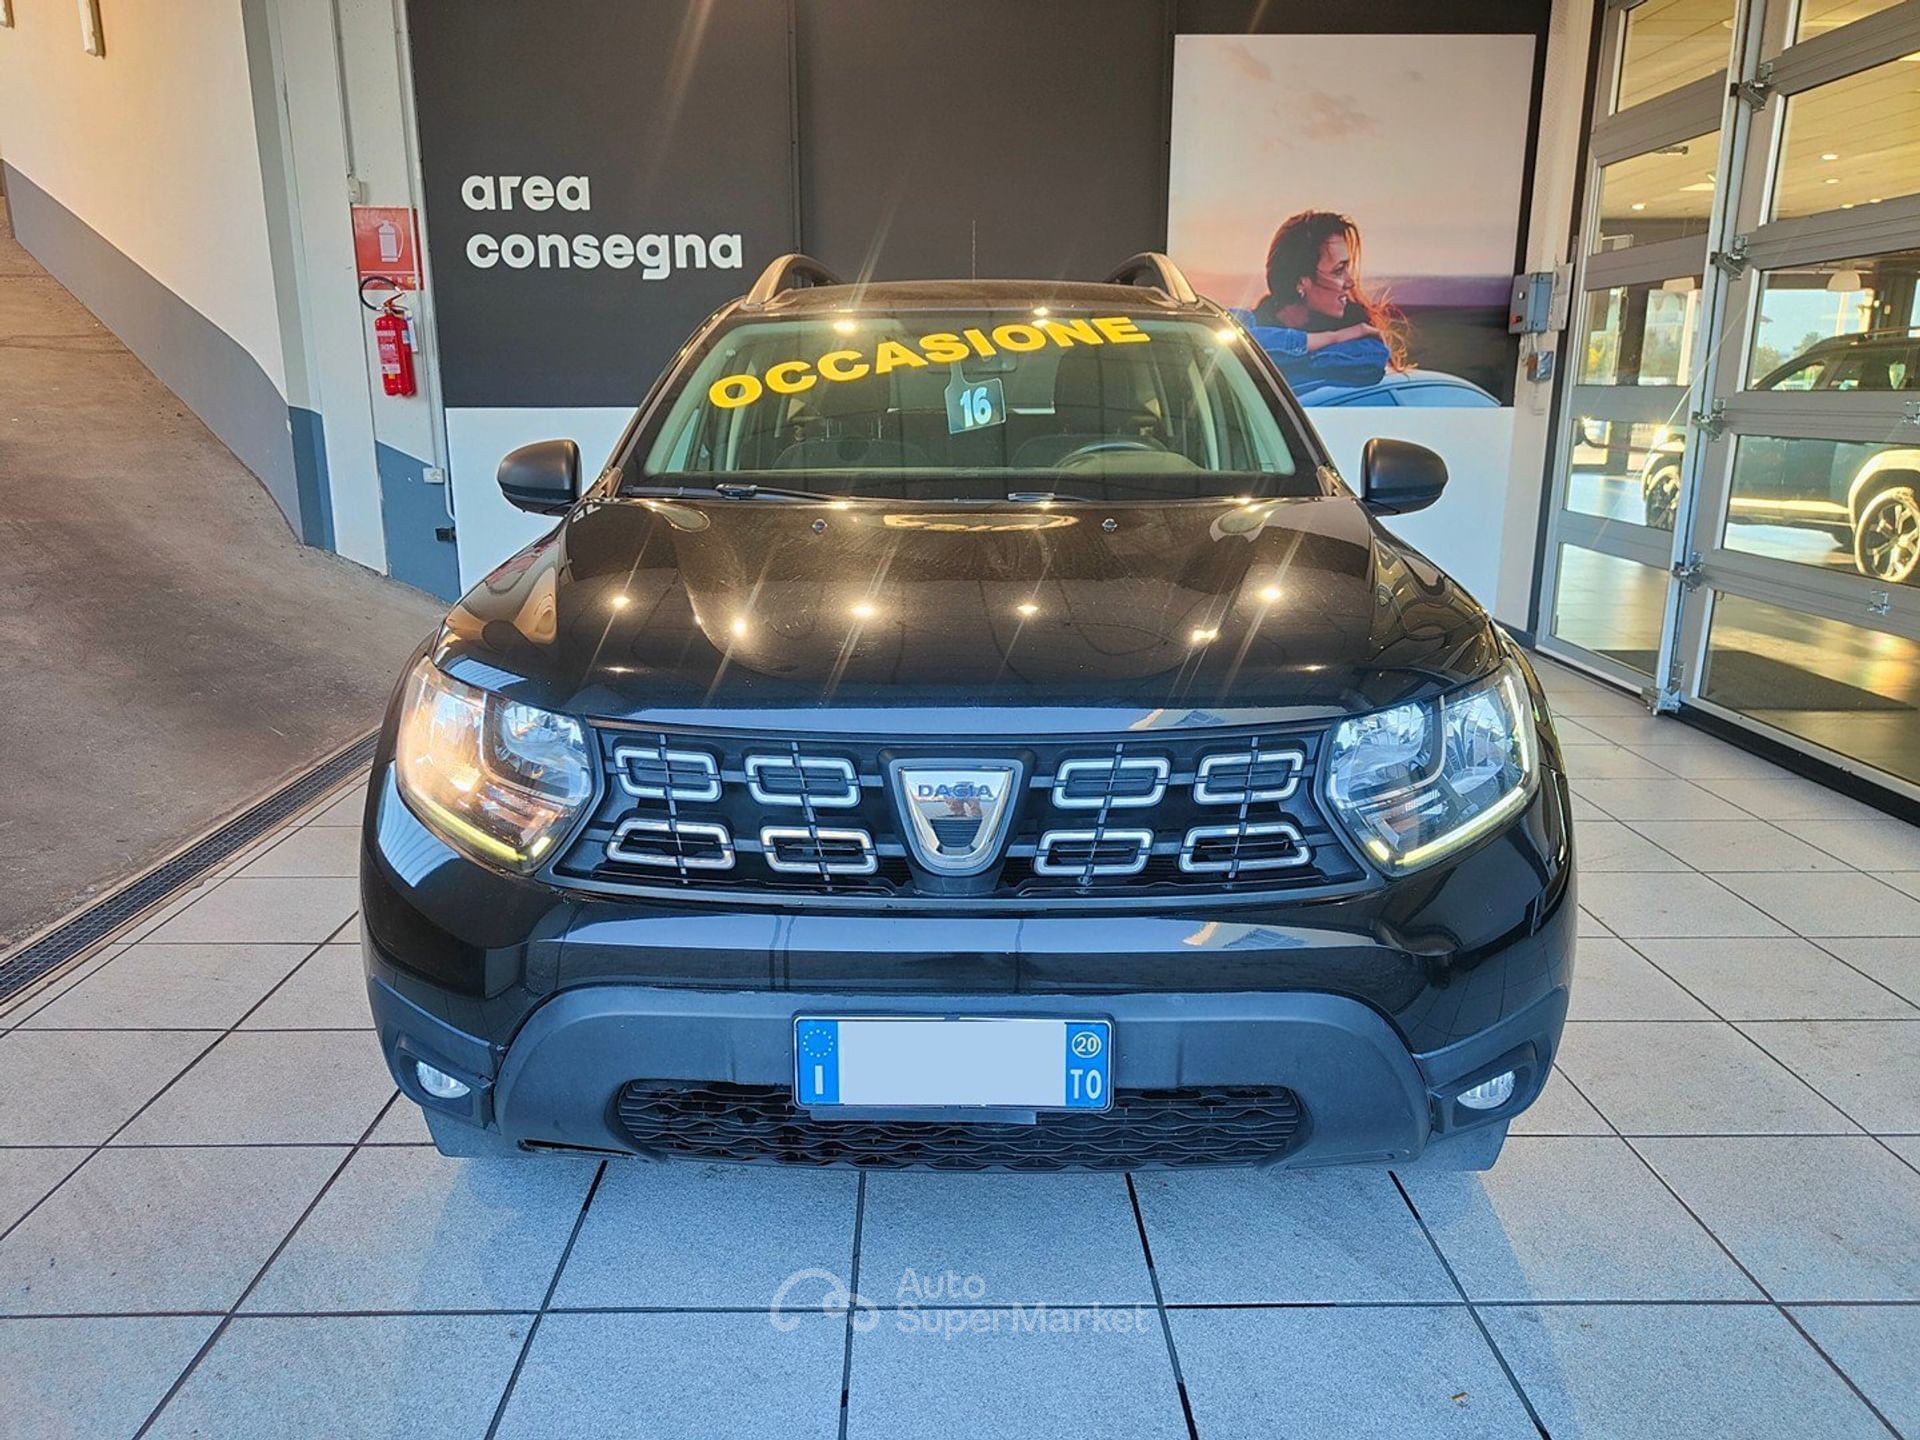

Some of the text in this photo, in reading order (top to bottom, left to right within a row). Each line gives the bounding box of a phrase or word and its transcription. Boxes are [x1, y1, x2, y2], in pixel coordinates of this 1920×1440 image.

[461, 175, 590, 211] area
[466, 233, 743, 280] consegna
[708, 316, 1151, 408] OCCASIONE
[960, 386, 992, 428] 16
[917, 784, 995, 798] DACIA
[1076, 1036, 1098, 1053] 20
[814, 1064, 824, 1095] I
[1070, 1069, 1102, 1100] TO
